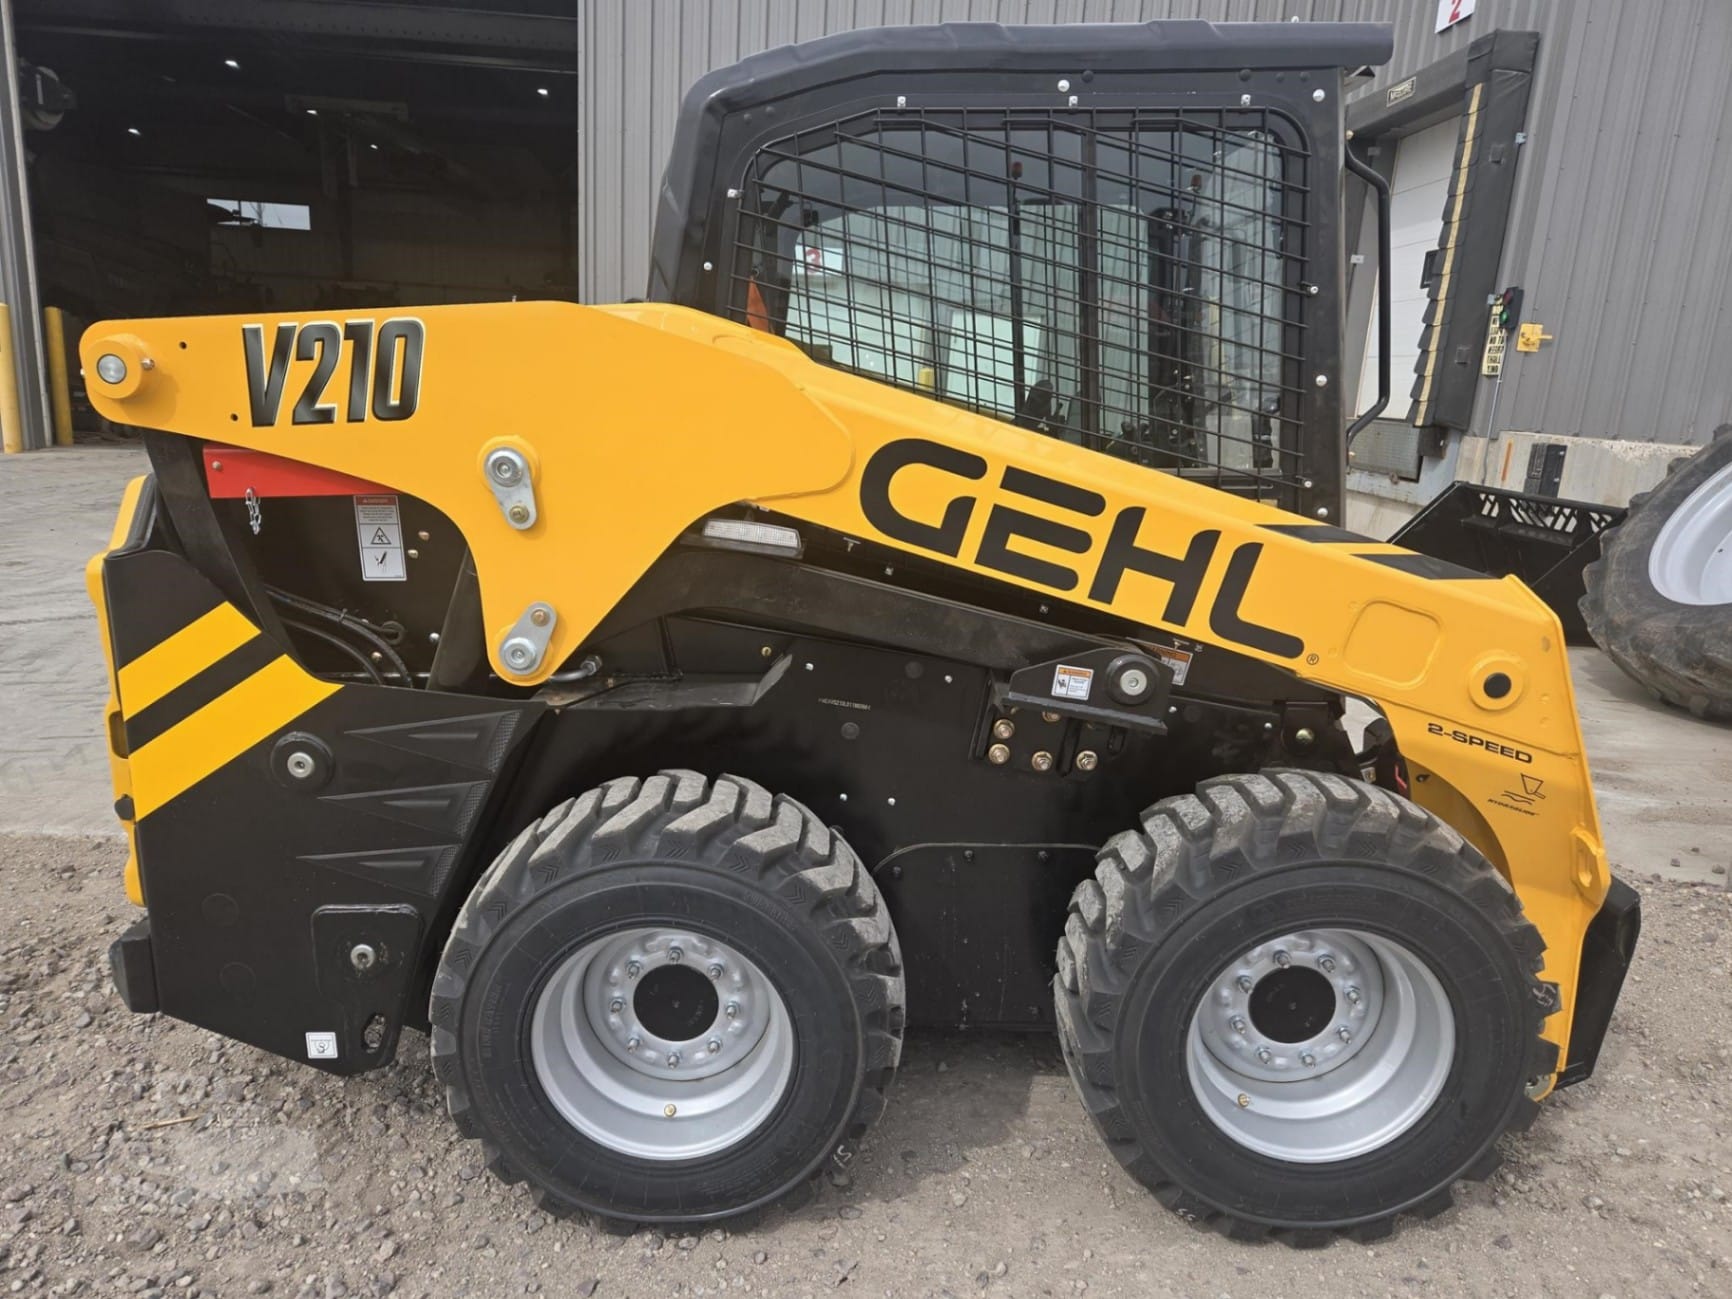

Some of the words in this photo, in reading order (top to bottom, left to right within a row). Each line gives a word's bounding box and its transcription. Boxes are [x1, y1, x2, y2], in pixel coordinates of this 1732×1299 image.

[242, 318, 424, 427] V210
[860, 438, 1304, 659] GEHL
[1428, 722, 1532, 764] 2-SPEED
